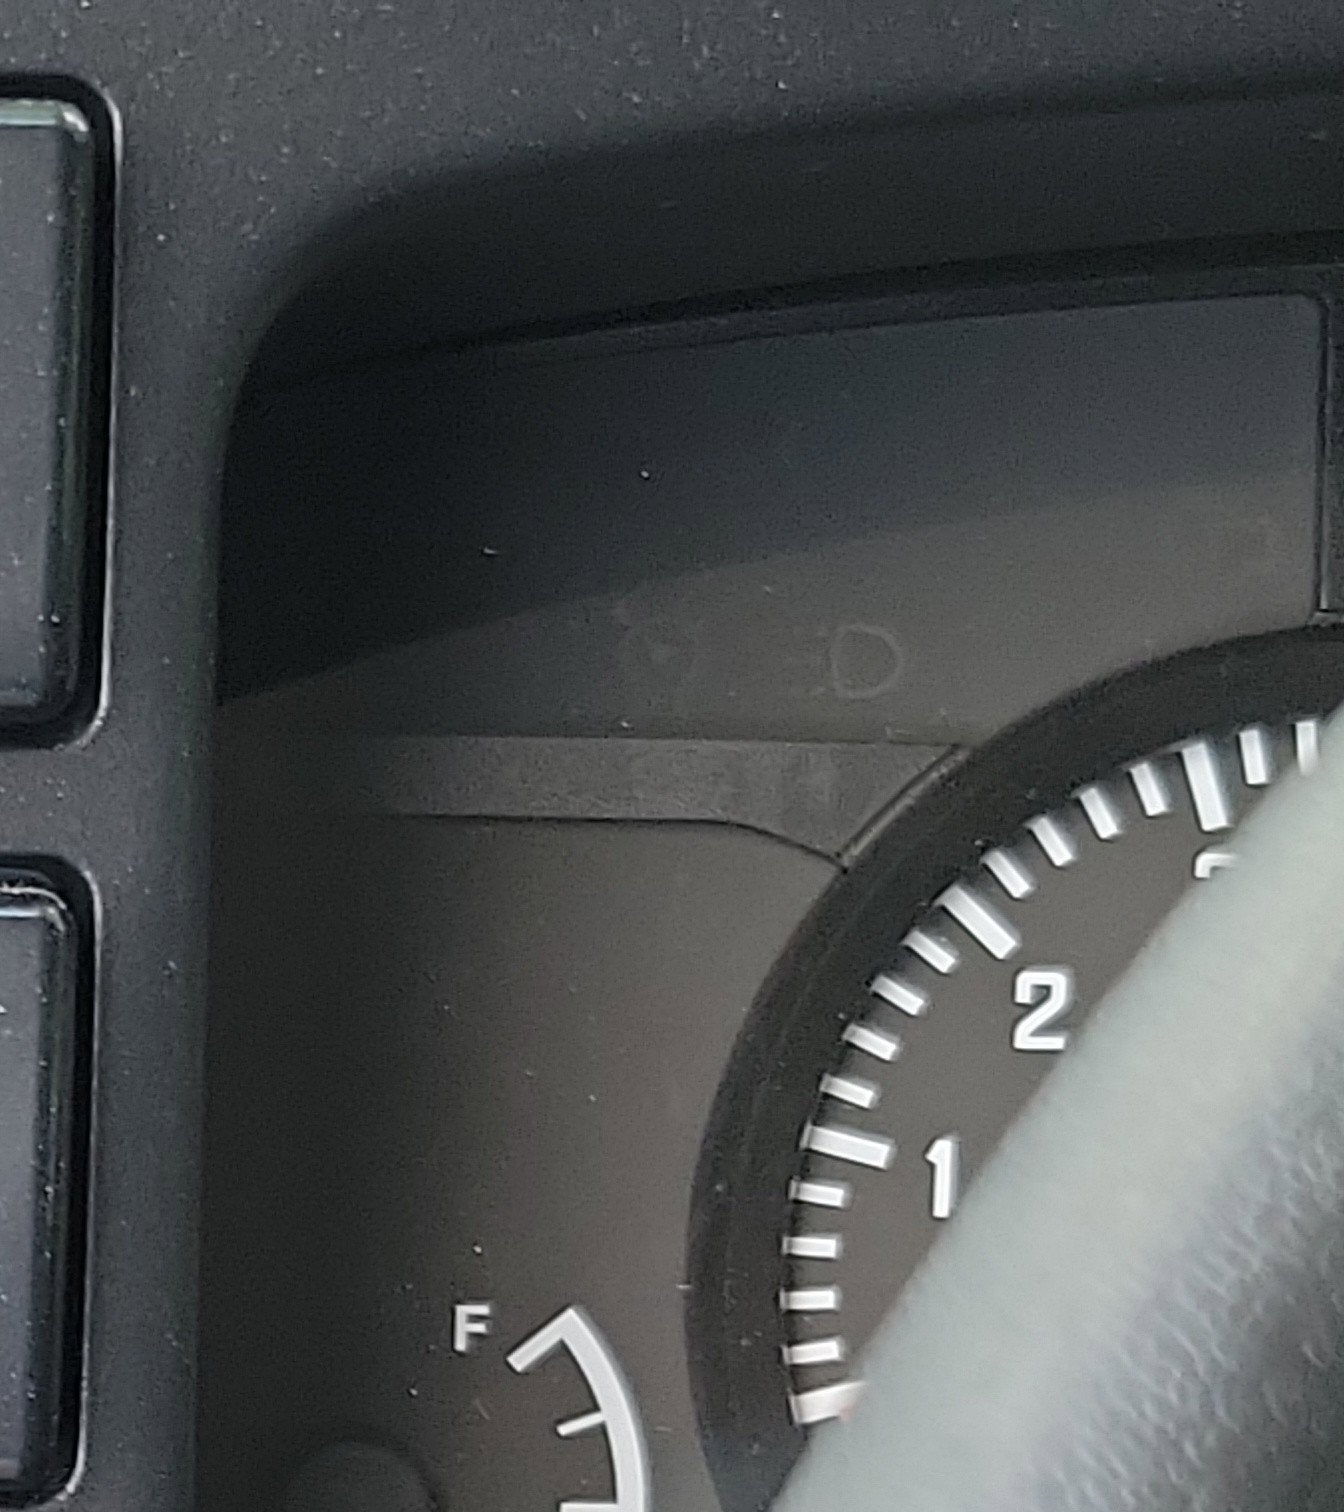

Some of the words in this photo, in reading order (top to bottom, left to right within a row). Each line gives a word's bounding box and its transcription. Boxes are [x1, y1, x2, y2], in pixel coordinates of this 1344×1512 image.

[1013, 970, 1070, 1051] 2
[924, 1137, 956, 1219] 1
[453, 1303, 491, 1352] F
